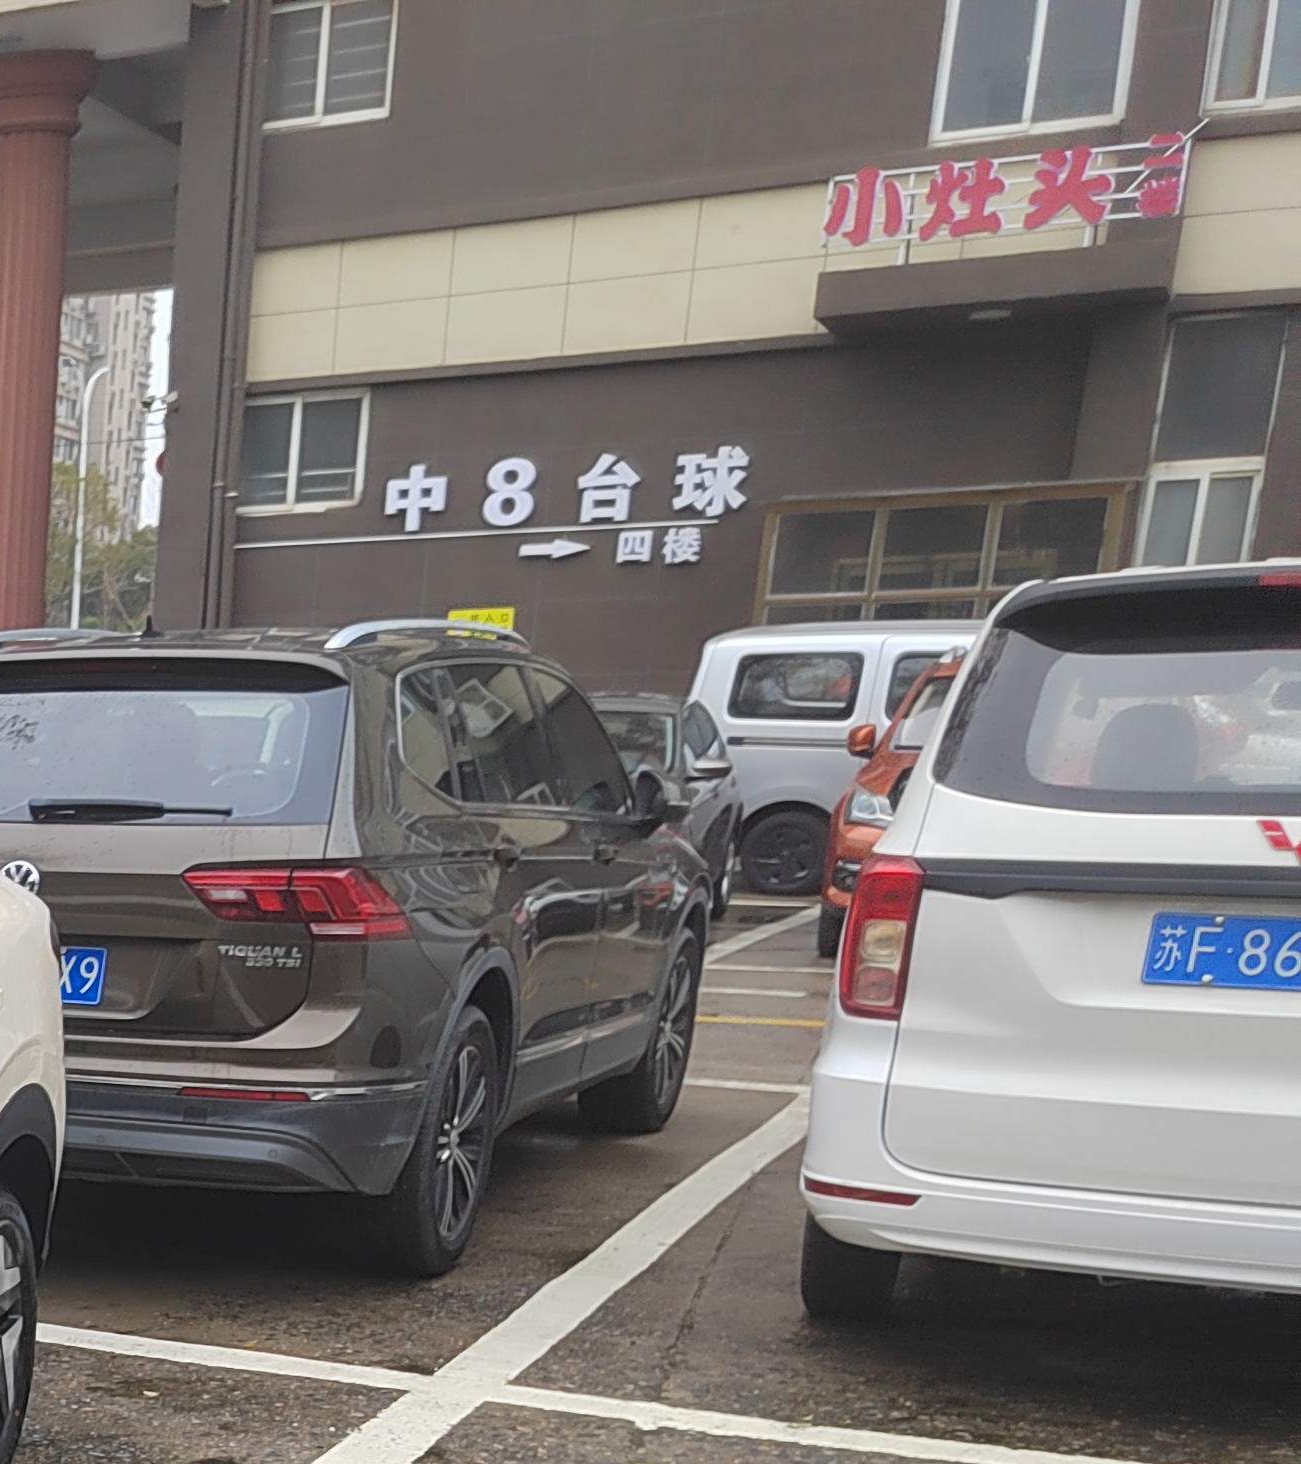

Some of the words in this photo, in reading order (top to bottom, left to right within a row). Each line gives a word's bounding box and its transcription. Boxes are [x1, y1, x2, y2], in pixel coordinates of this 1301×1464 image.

[823, 144, 1115, 248] 小灶头
[383, 445, 751, 534] 中8台球
[614, 527, 703, 565] 四楼
[217, 944, 287, 958] TIGUAN
[291, 946, 303, 958] L
